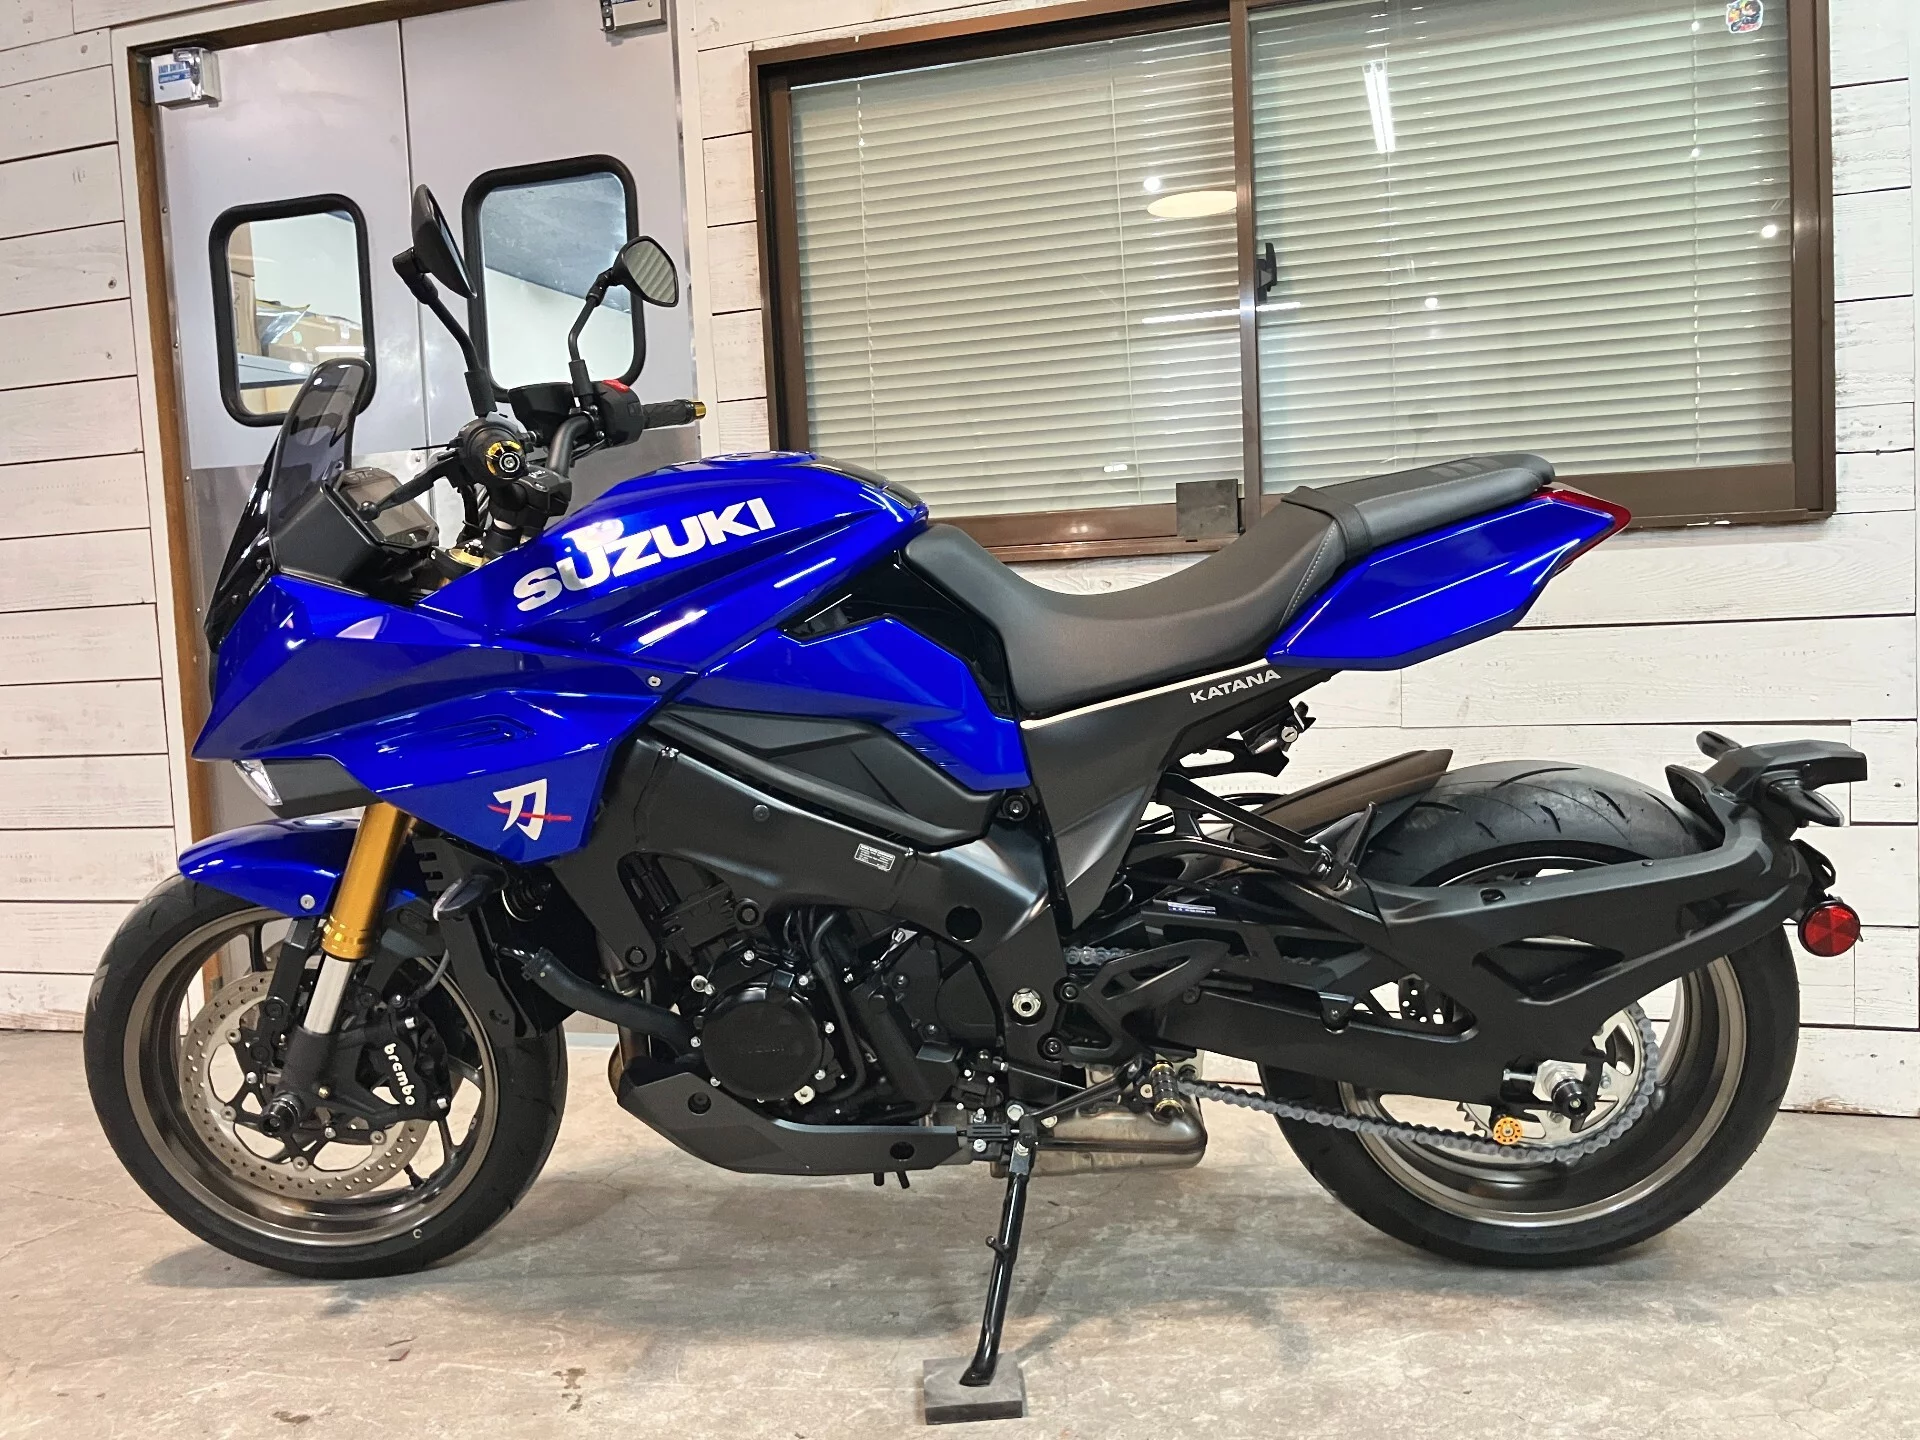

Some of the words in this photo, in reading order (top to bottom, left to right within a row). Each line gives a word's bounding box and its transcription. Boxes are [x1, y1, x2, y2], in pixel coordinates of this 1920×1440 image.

[513, 497, 776, 612] SUZUKI
[1190, 669, 1282, 704] KATANA
[492, 778, 548, 841] 刀
[384, 1042, 416, 1106] brembo
